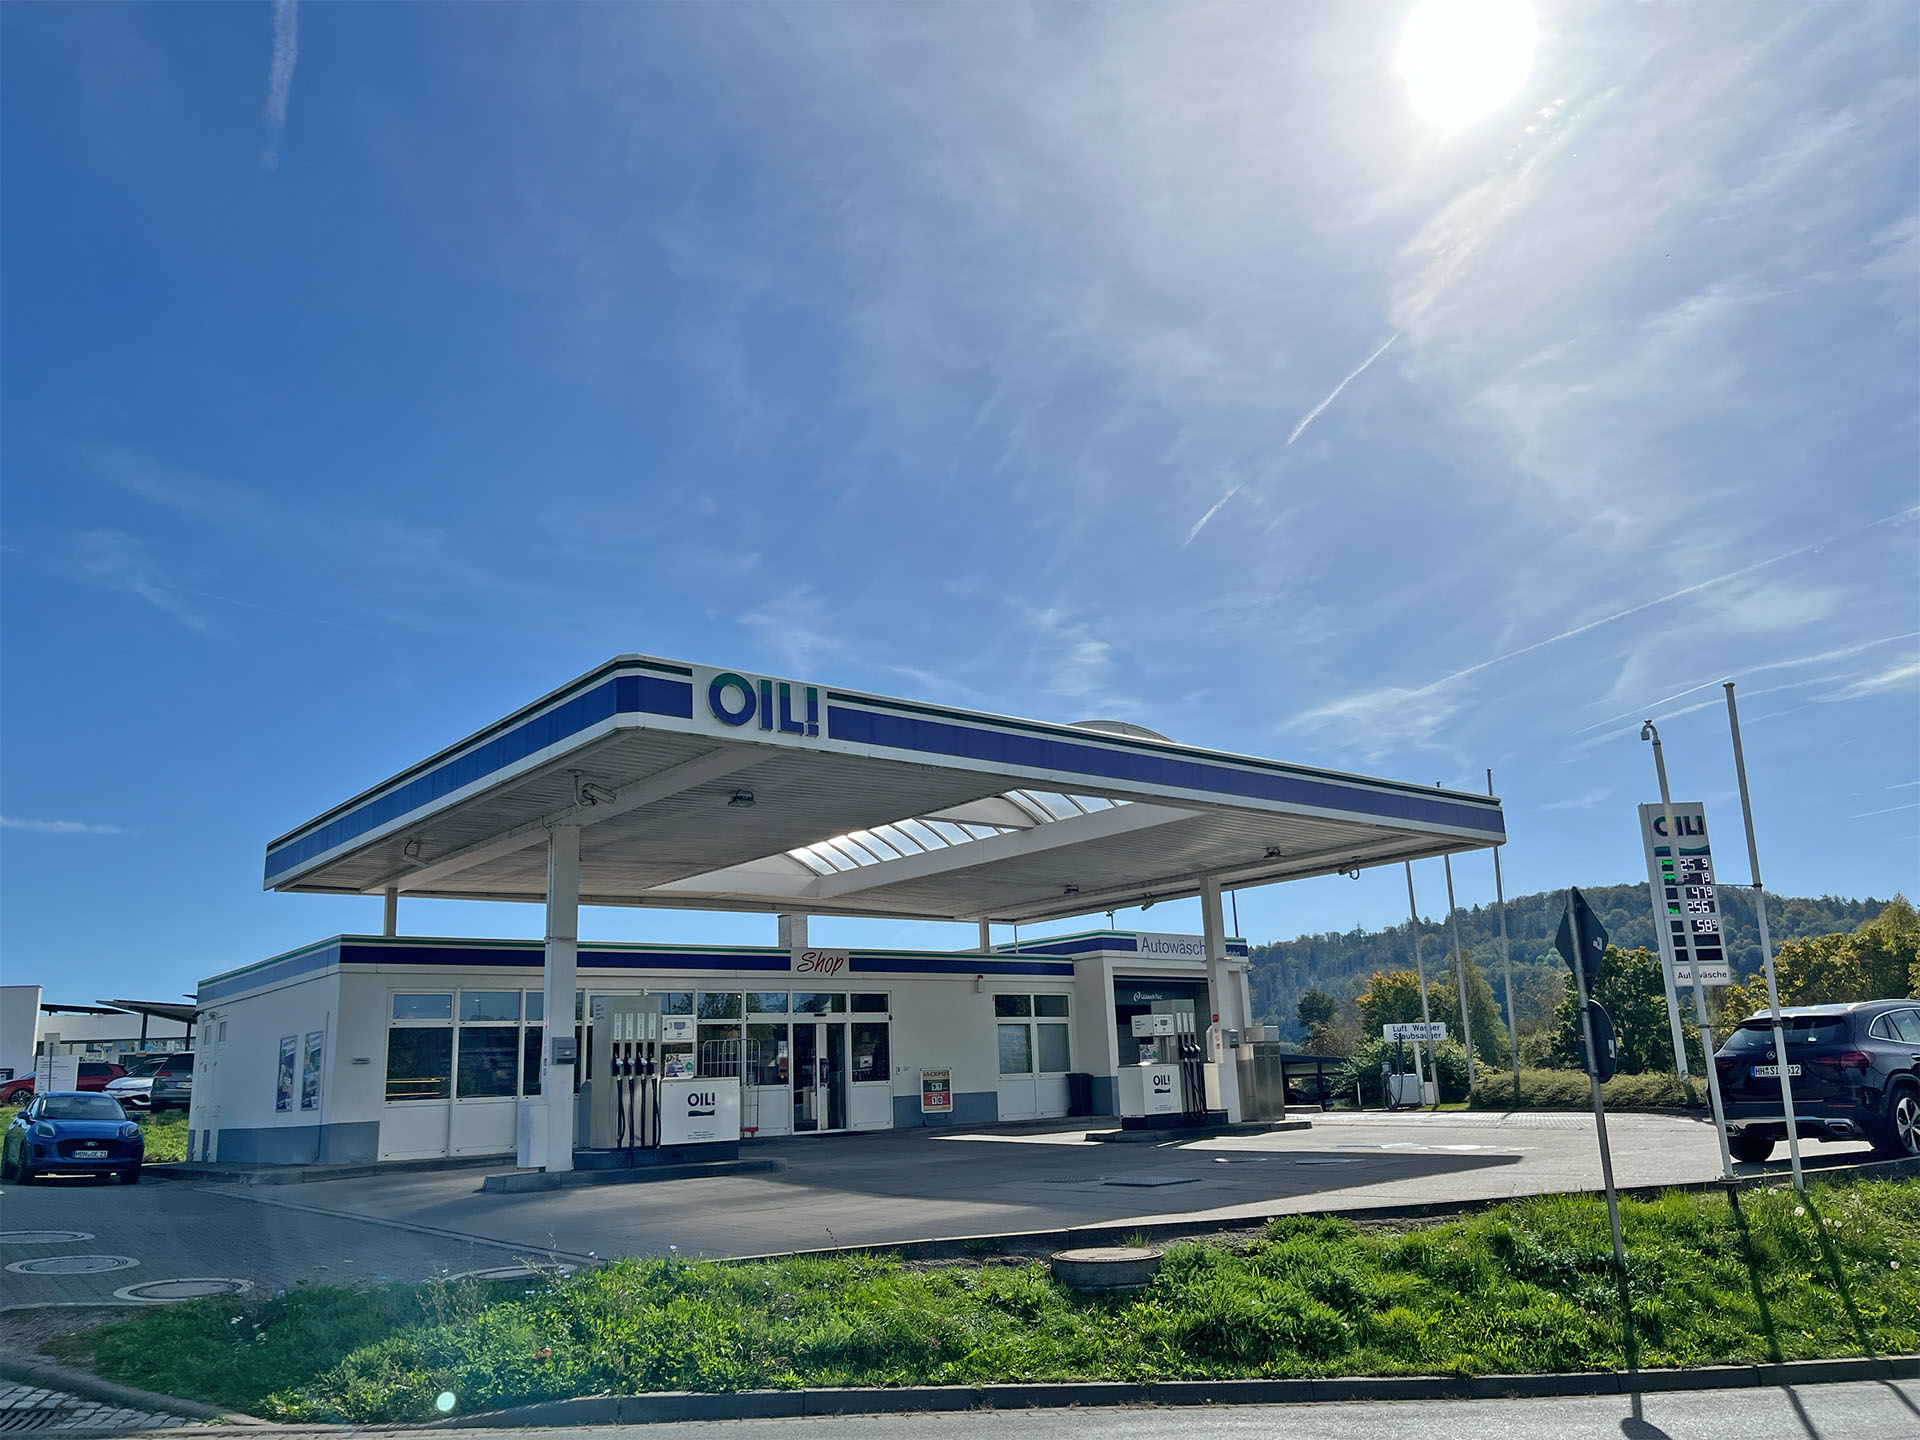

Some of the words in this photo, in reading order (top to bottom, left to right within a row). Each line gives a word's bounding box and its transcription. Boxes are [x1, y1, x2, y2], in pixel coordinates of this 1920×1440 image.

[708, 672, 819, 737] OIL!
[1141, 936, 1207, 956] Autowäsch
[797, 951, 844, 977] Shop
[1677, 971, 1728, 980] Autäsche
[1392, 1025, 1408, 1033] Luft
[1153, 1075, 1171, 1086] OIL!
[687, 1092, 716, 1107] OIL!
